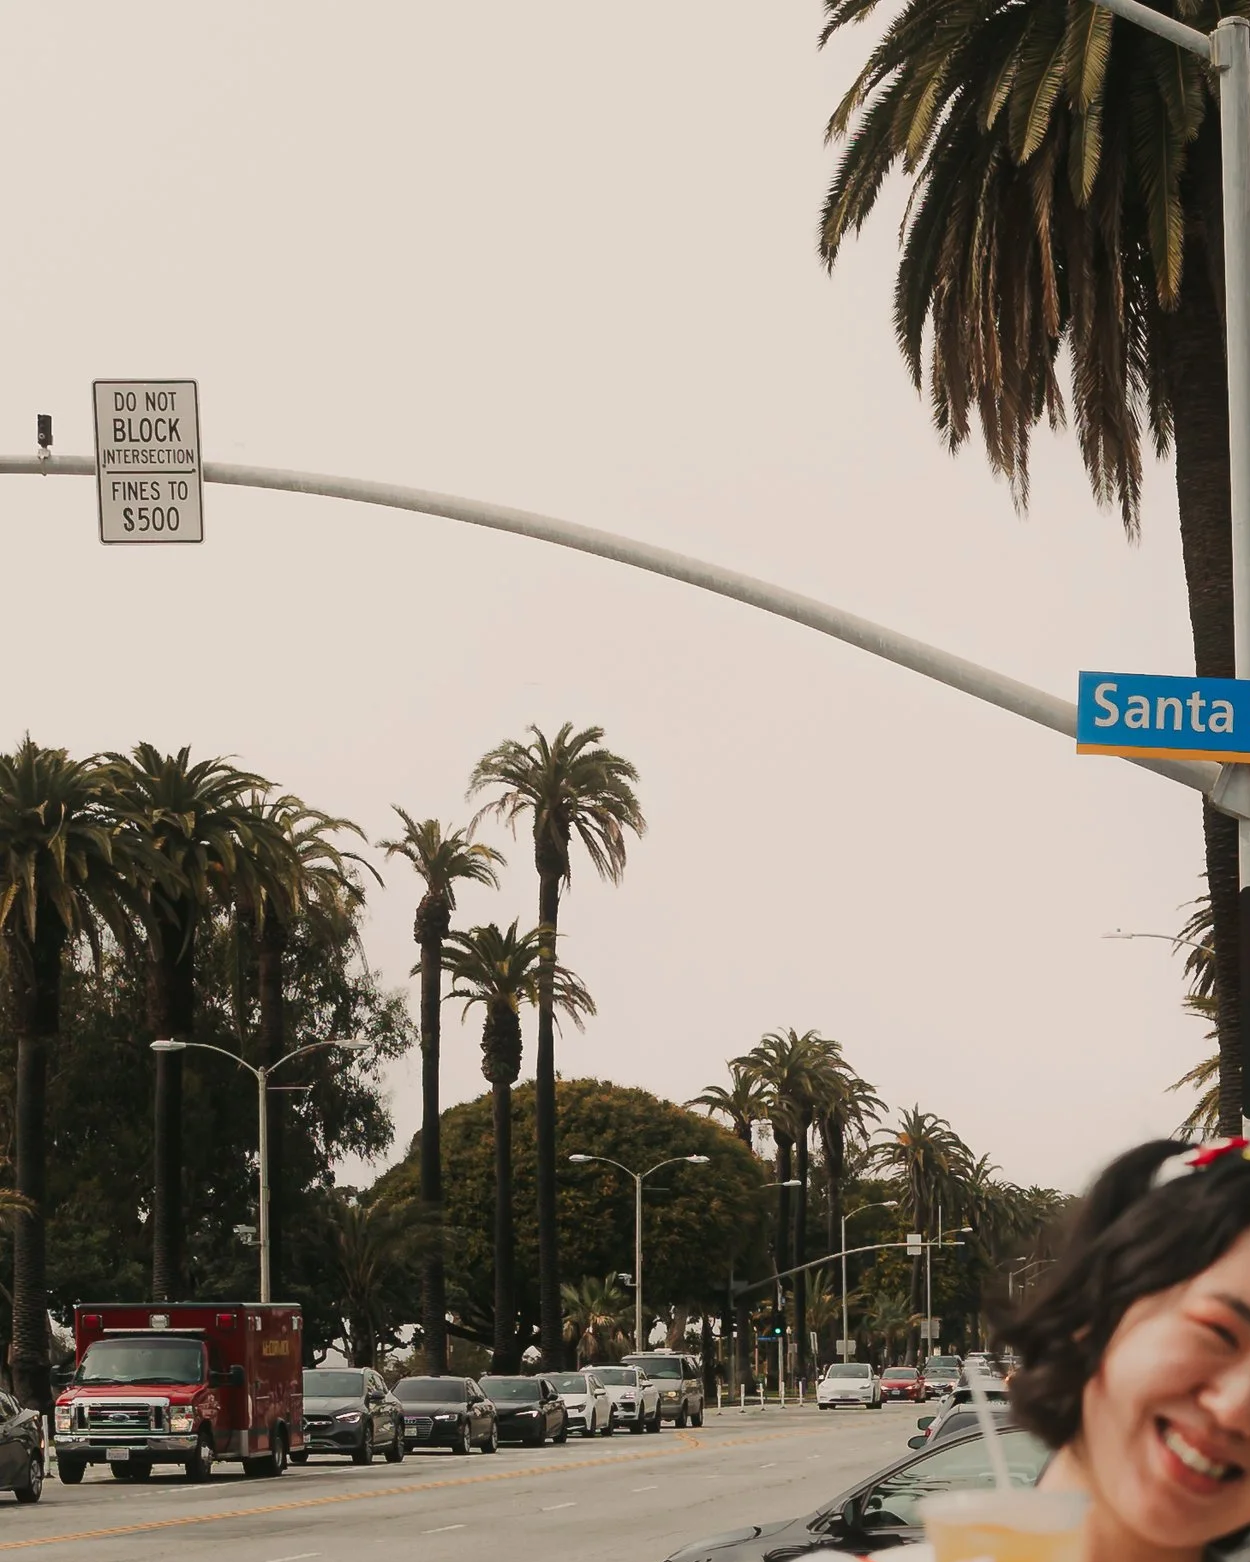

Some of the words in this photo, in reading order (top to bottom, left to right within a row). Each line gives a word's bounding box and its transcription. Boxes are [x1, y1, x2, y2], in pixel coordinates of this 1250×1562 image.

[113, 391, 137, 412] DO
[145, 391, 177, 411] NOT
[112, 417, 182, 442] BLOCK
[102, 448, 195, 464] INTERSECTION
[111, 481, 161, 501] FINES
[168, 481, 188, 500] TO
[122, 506, 180, 532] $500
[1093, 682, 1234, 734] Santa
